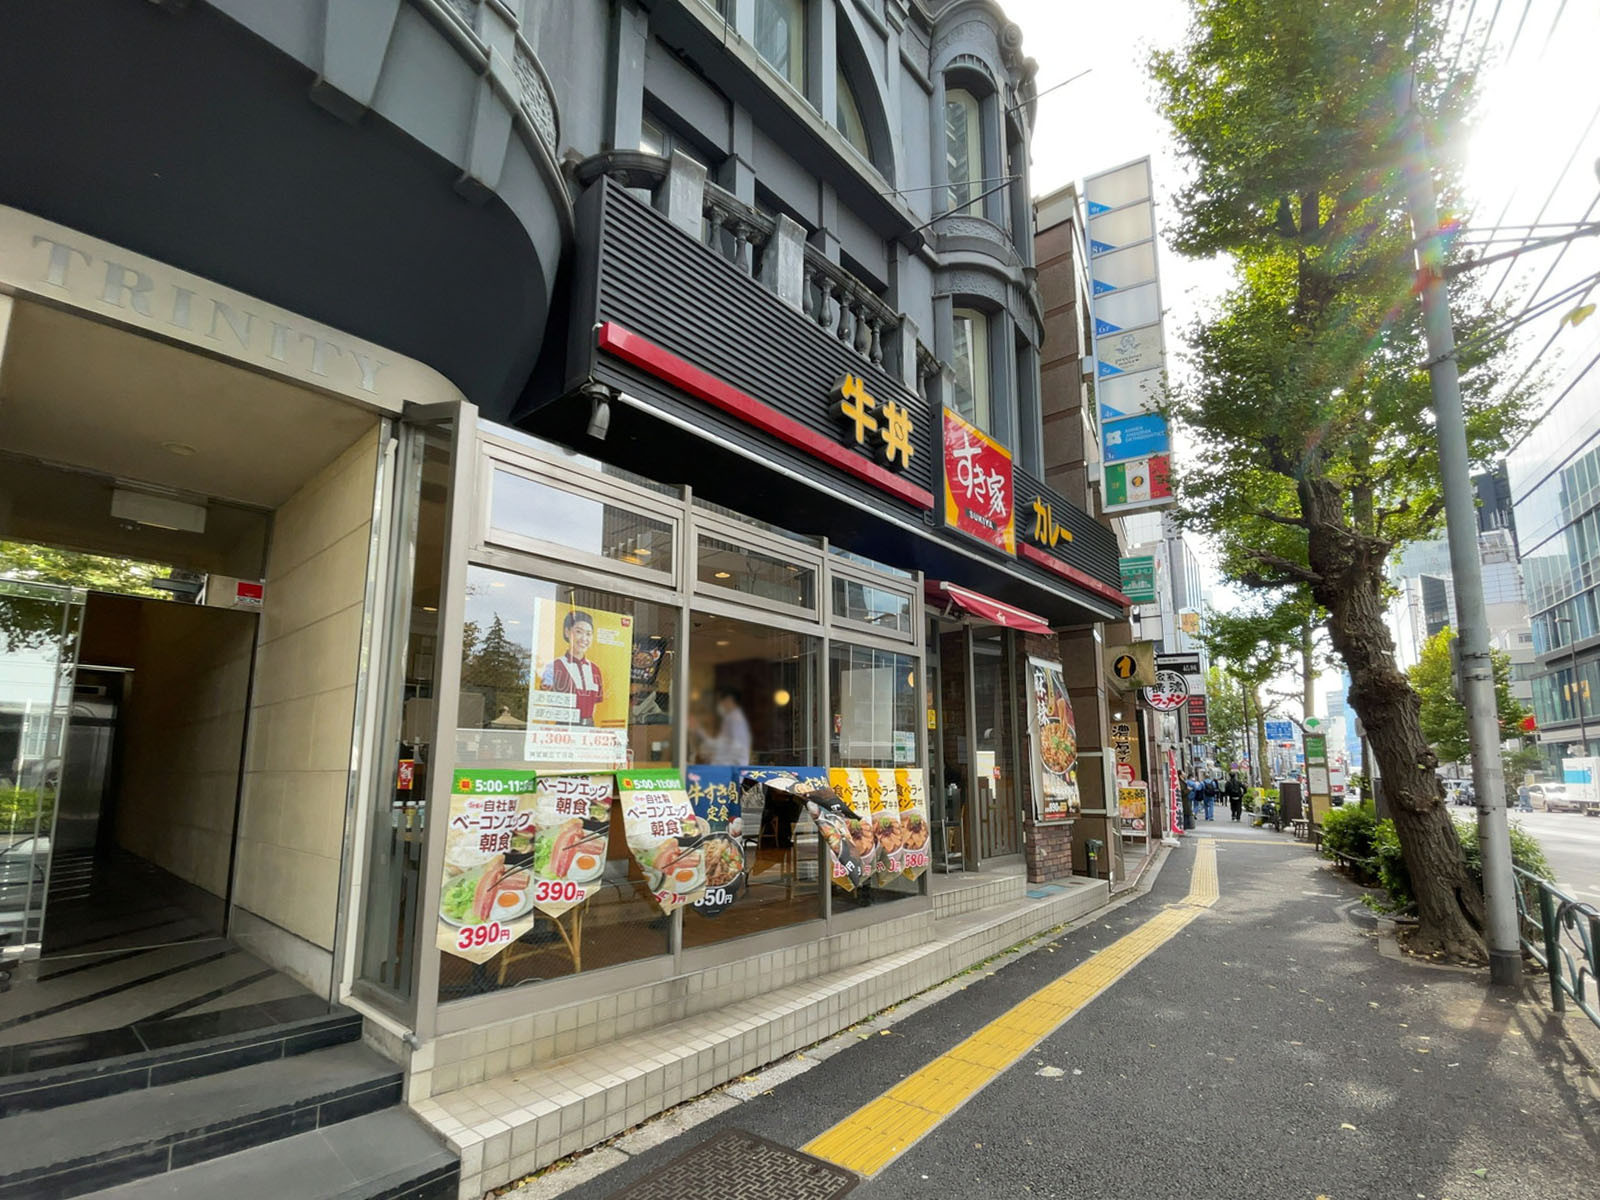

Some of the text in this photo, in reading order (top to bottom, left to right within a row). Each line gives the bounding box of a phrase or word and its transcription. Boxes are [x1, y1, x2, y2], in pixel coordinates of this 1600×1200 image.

[32, 235, 390, 395] TRINITY
[841, 373, 914, 469] 牛丼
[952, 431, 1007, 518] すき家
[968, 510, 994, 530] SUKIYA
[1033, 495, 1073, 549] カレー
[536, 779, 610, 798] ベーコンエッグ
[556, 796, 588, 816] 朝食
[453, 811, 534, 830] ベーコンエッグ
[650, 819, 680, 837] 朝食
[479, 831, 511, 853] 朝食
[535, 881, 585, 902] 390円
[457, 921, 510, 950] 390円
